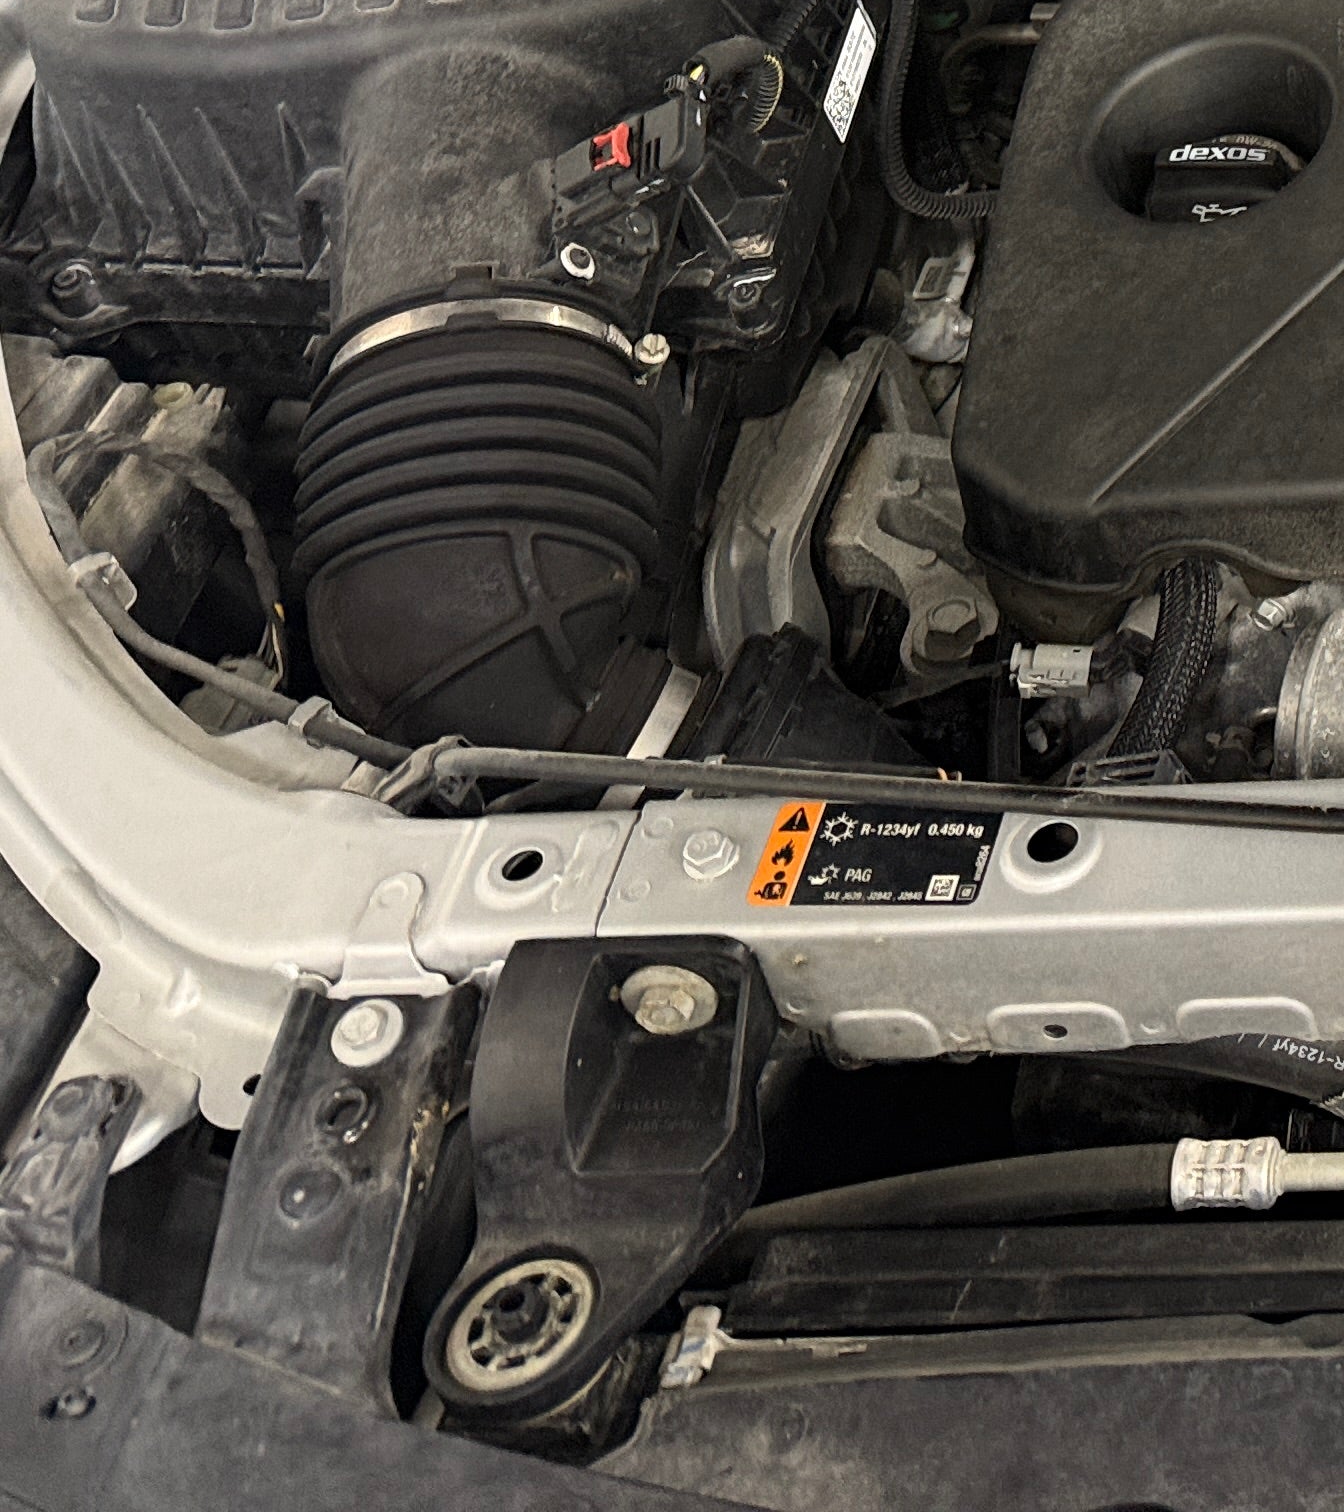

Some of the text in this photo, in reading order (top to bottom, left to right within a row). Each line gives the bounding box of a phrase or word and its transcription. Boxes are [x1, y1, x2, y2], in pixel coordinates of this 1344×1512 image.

[1168, 143, 1270, 162] dexos
[860, 823, 984, 839] R-1234yf 0.450 kg
[844, 868, 873, 883] PAG
